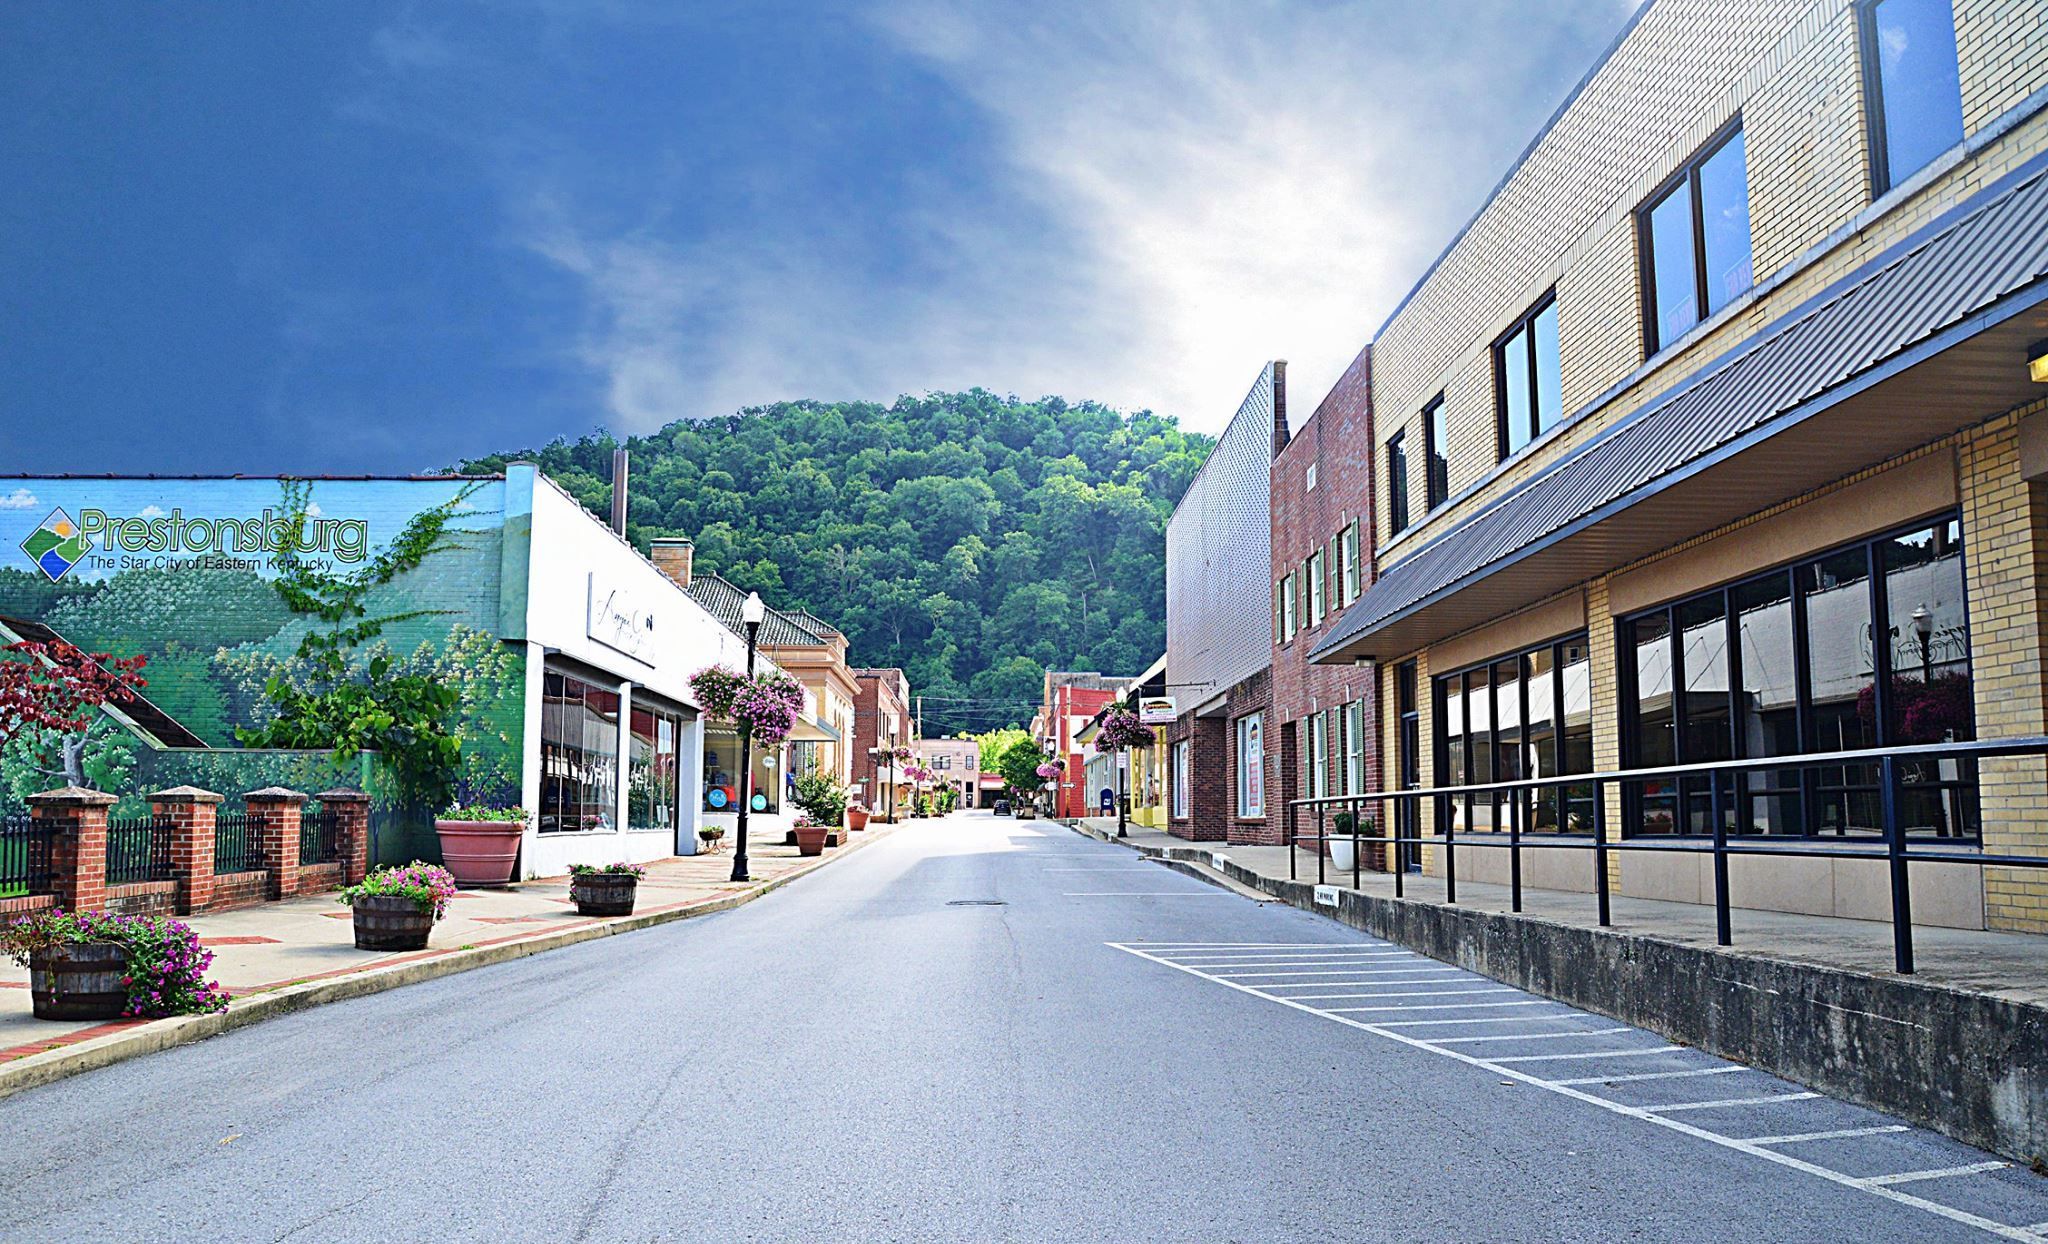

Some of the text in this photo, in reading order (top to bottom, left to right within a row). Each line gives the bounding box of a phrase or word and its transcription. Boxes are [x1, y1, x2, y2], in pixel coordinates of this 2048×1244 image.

[78, 508, 368, 563] Prestonsburg
[88, 555, 115, 569] The
[120, 555, 150, 569] Star
[154, 555, 182, 573] City
[186, 555, 200, 569] of
[205, 557, 261, 570] Eastern
